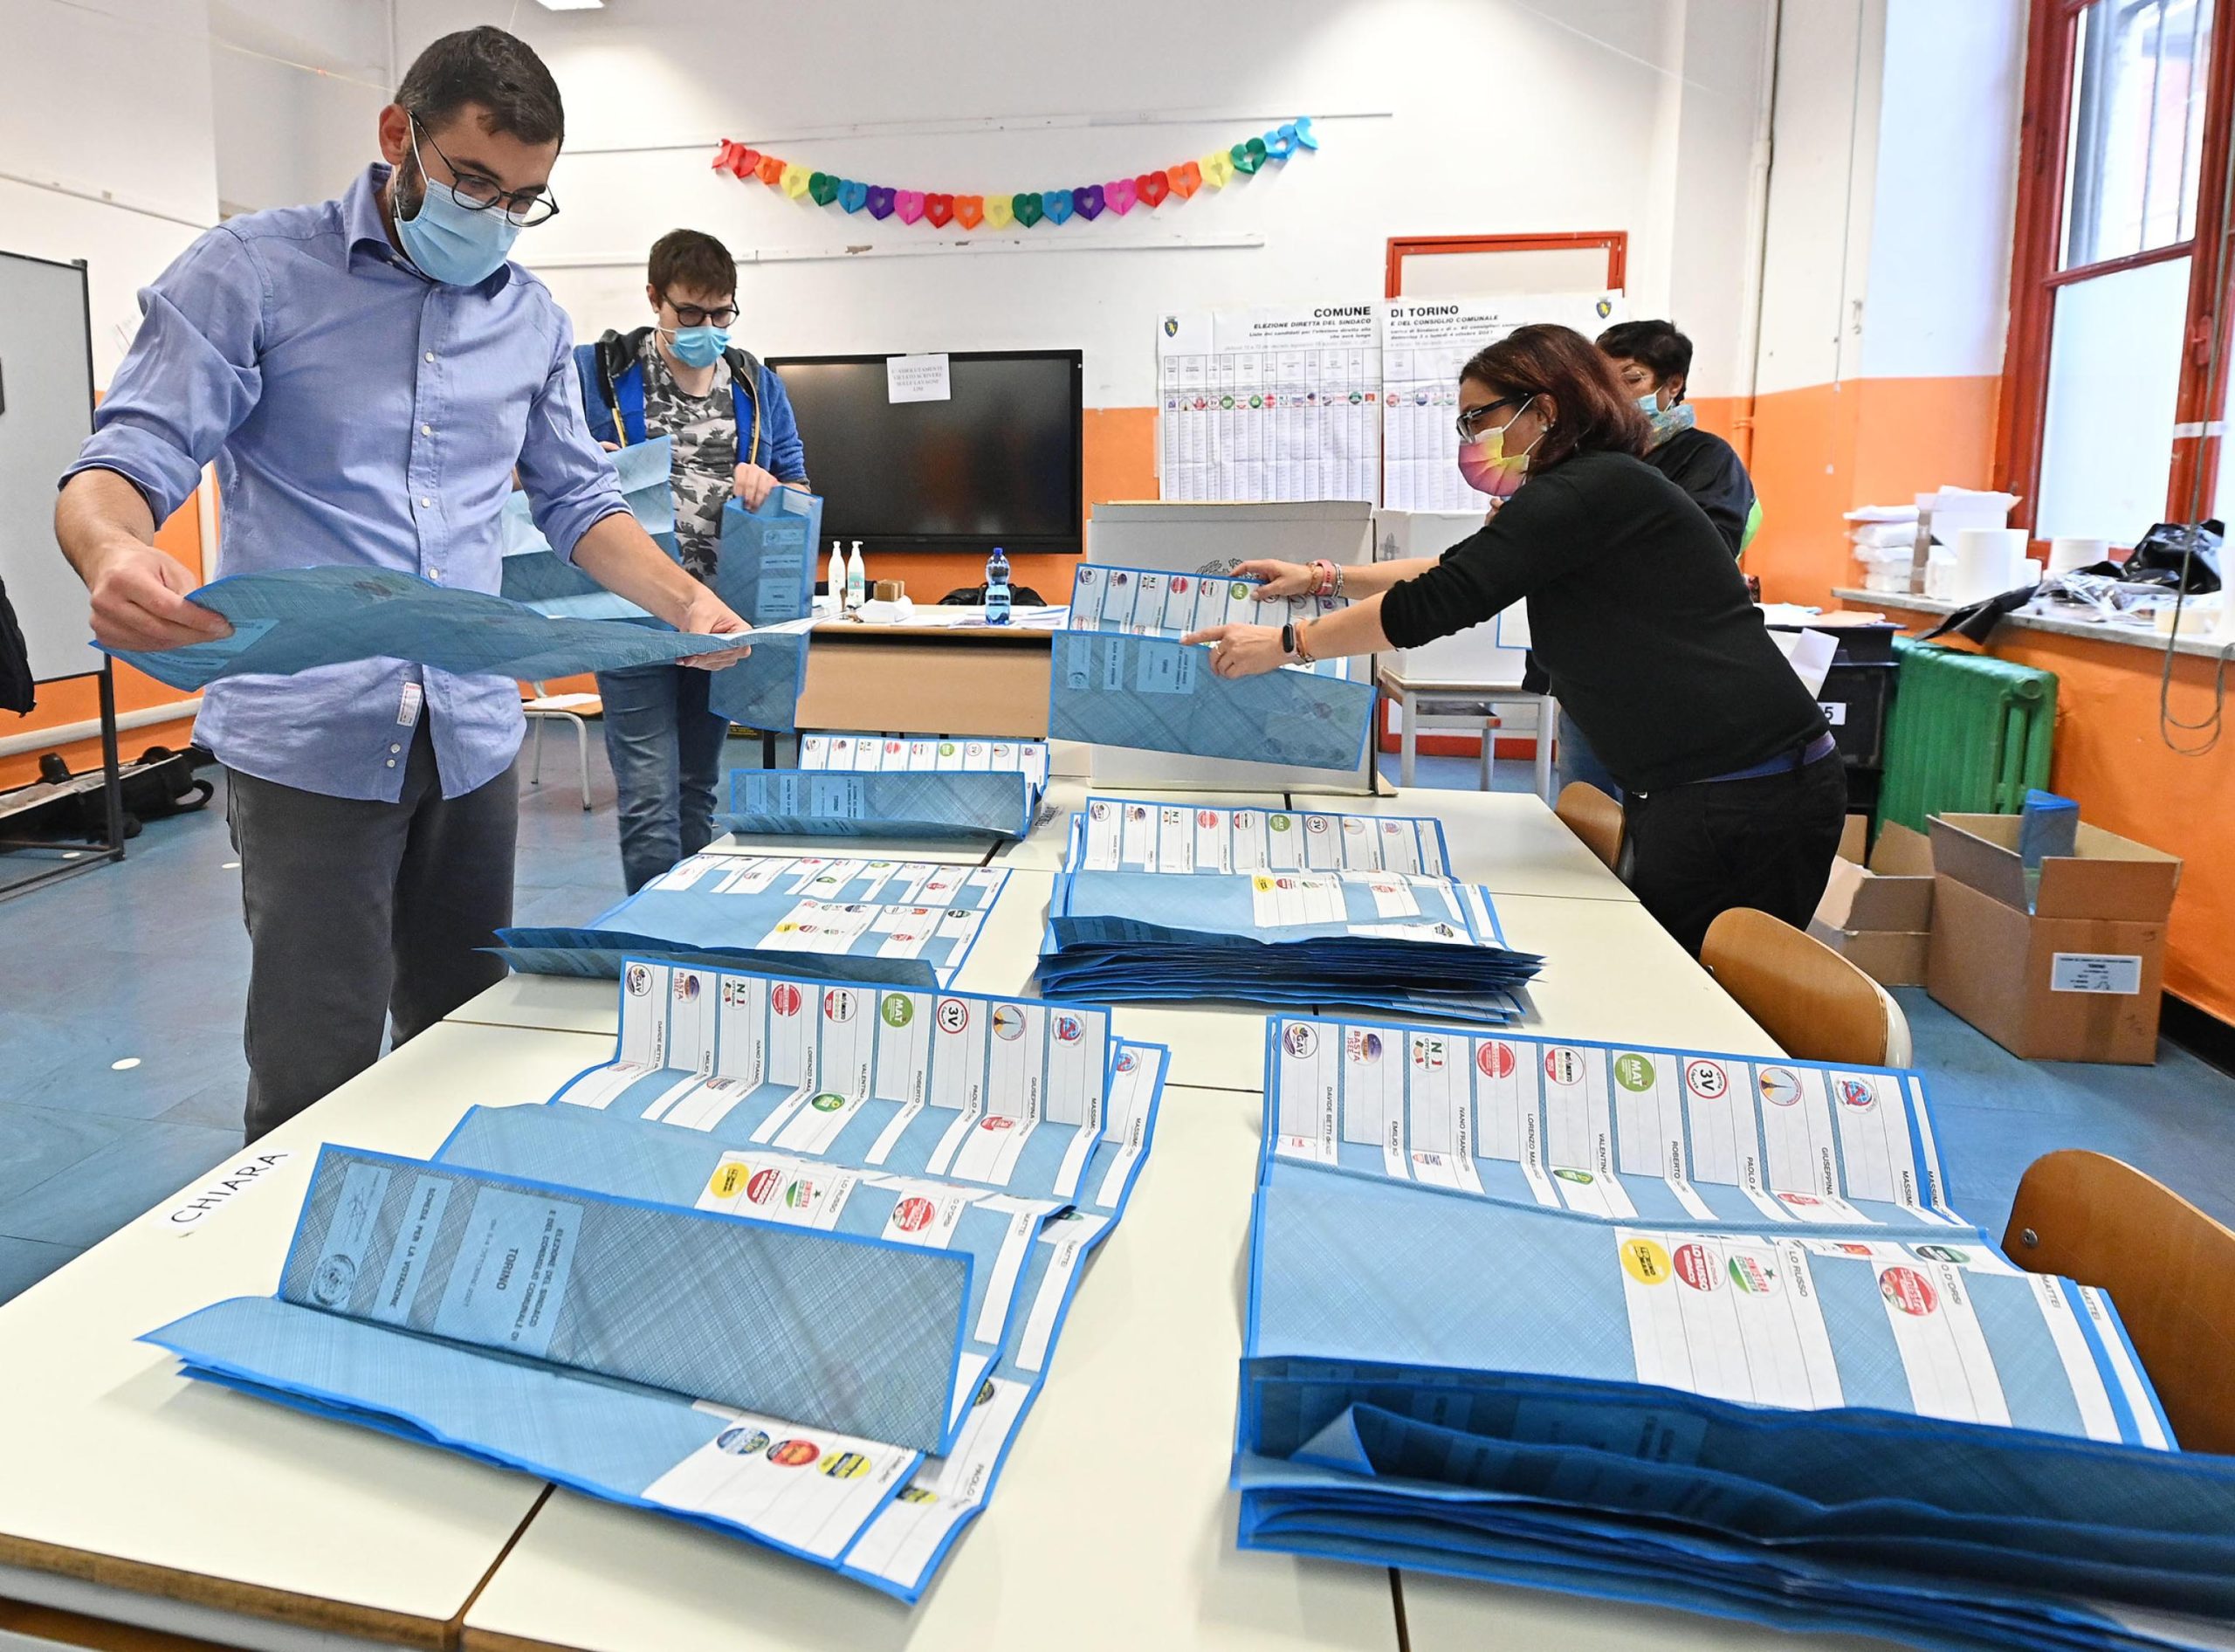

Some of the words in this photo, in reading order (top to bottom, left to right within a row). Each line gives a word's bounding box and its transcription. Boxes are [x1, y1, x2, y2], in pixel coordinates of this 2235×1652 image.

[1314, 306, 1372, 318] COMUNE
[1390, 309, 1404, 318] DI
[1408, 305, 1459, 317] TORINO
[634, 975, 643, 994] GAY
[736, 983, 746, 1005] NI
[893, 998, 903, 1022] MAT
[948, 1006, 959, 1027] 3V
[1353, 1030, 1362, 1062] BASTA
[1630, 1059, 1642, 1087] MAT
[1700, 1069, 1715, 1091] 3V
[1599, 1133, 1607, 1174] VALENTINA
[1746, 1156, 1755, 1184] PAOLO
[1821, 1146, 1833, 1195] GIUSEPPINA
[171, 1153, 289, 1223] CHIARA
[417, 1187, 437, 1222] SCHEDA
[411, 1225, 423, 1242] PER
[543, 1218, 554, 1232] DEL
[407, 1245, 416, 1257] LA
[533, 1235, 552, 1282] CONSIGLIO
[547, 1228, 564, 1271] ELEZIONE
[1691, 1246, 1701, 1257] LO
[389, 1262, 411, 1308] VOTAZIONE
[496, 1248, 519, 1291] TORINO
[542, 1273, 554, 1289] DEL
[1695, 1259, 1709, 1291] RUSSO
[1744, 1256, 1770, 1293] SINISTRA
[1789, 1251, 1799, 1263] LO
[1794, 1265, 1808, 1298] RUSSO
[1944, 1273, 1963, 1305] D'ORSI
[516, 1284, 536, 1330] COMUNALE
[529, 1290, 548, 1328] SINDACO
